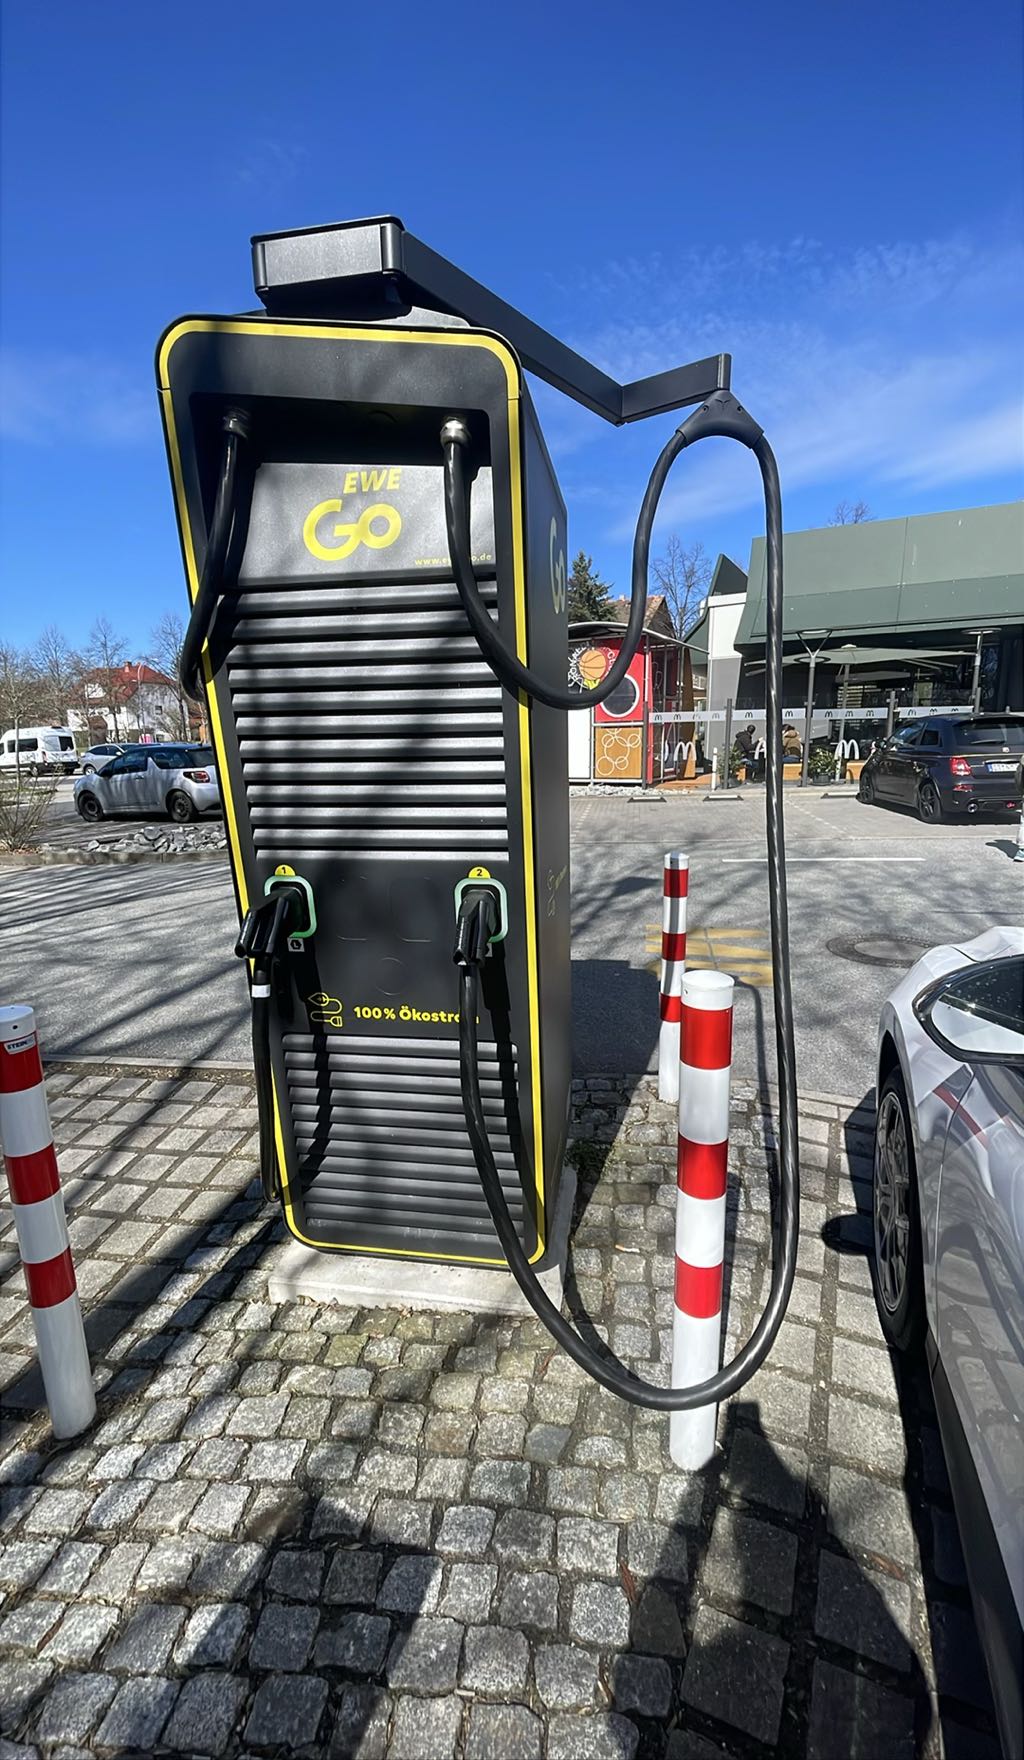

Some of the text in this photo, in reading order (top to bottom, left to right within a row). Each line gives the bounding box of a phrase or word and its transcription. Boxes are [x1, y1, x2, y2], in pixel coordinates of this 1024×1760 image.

[343, 468, 402, 494] EWE
[476, 868, 483, 877] 2
[399, 1005, 479, 1024] Ökostro
